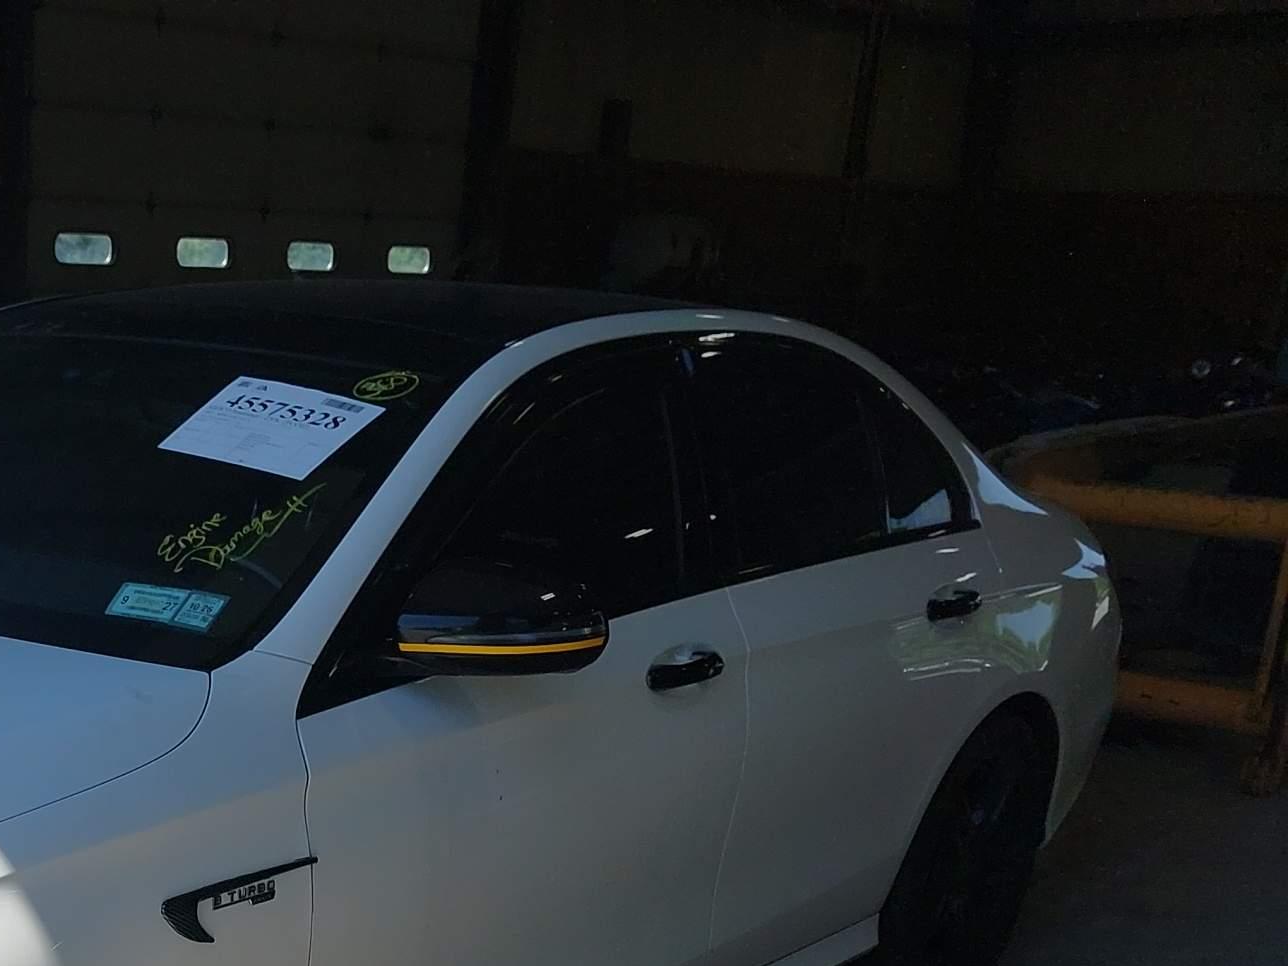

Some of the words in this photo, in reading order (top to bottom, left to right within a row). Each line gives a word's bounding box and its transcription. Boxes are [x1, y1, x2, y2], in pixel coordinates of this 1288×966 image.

[226, 394, 347, 431] 45575328
[158, 511, 227, 562] Engine
[174, 509, 283, 573] Damage
[228, 879, 276, 902] TURBO
